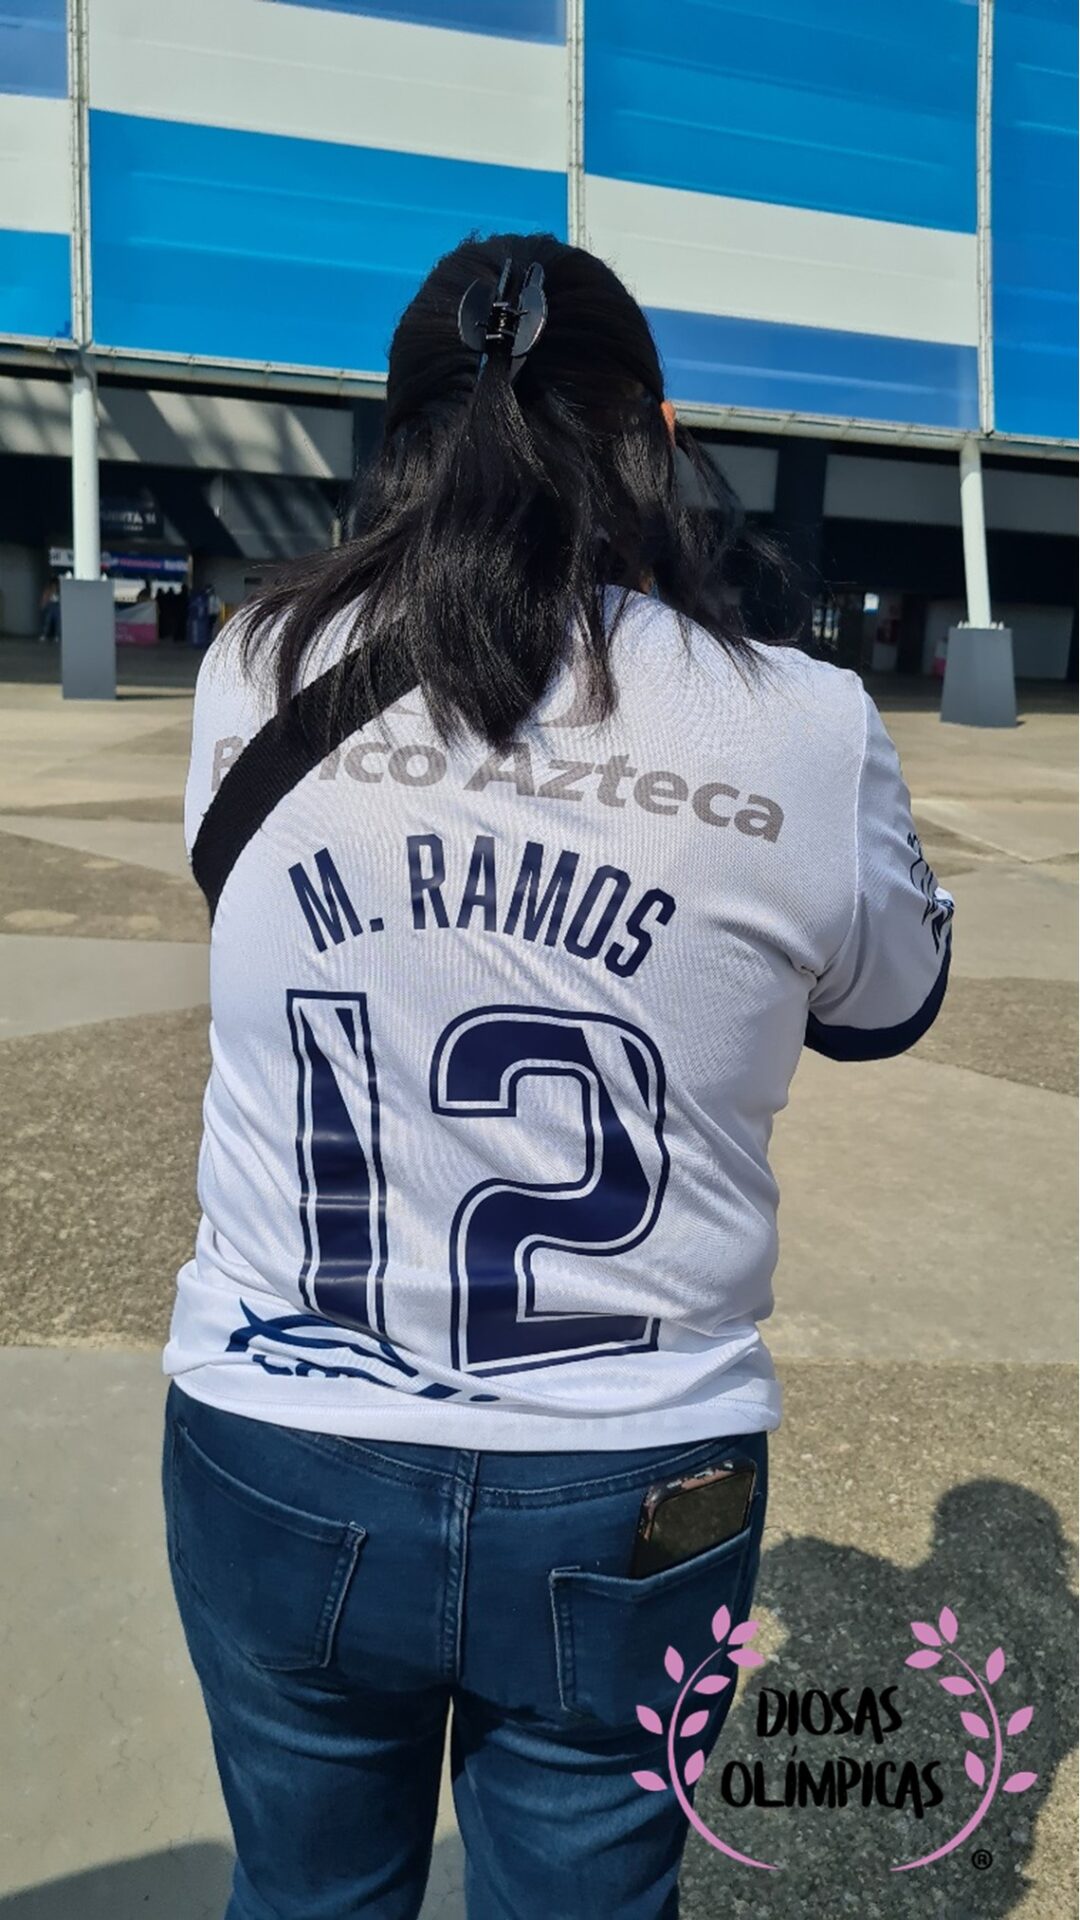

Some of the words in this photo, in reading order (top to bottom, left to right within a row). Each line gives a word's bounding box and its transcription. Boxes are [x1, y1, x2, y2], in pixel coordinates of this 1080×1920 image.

[463, 740, 786, 843] Azteca
[288, 847, 385, 953] M.
[406, 833, 677, 978] RAMOS
[286, 988, 670, 1377] 12
